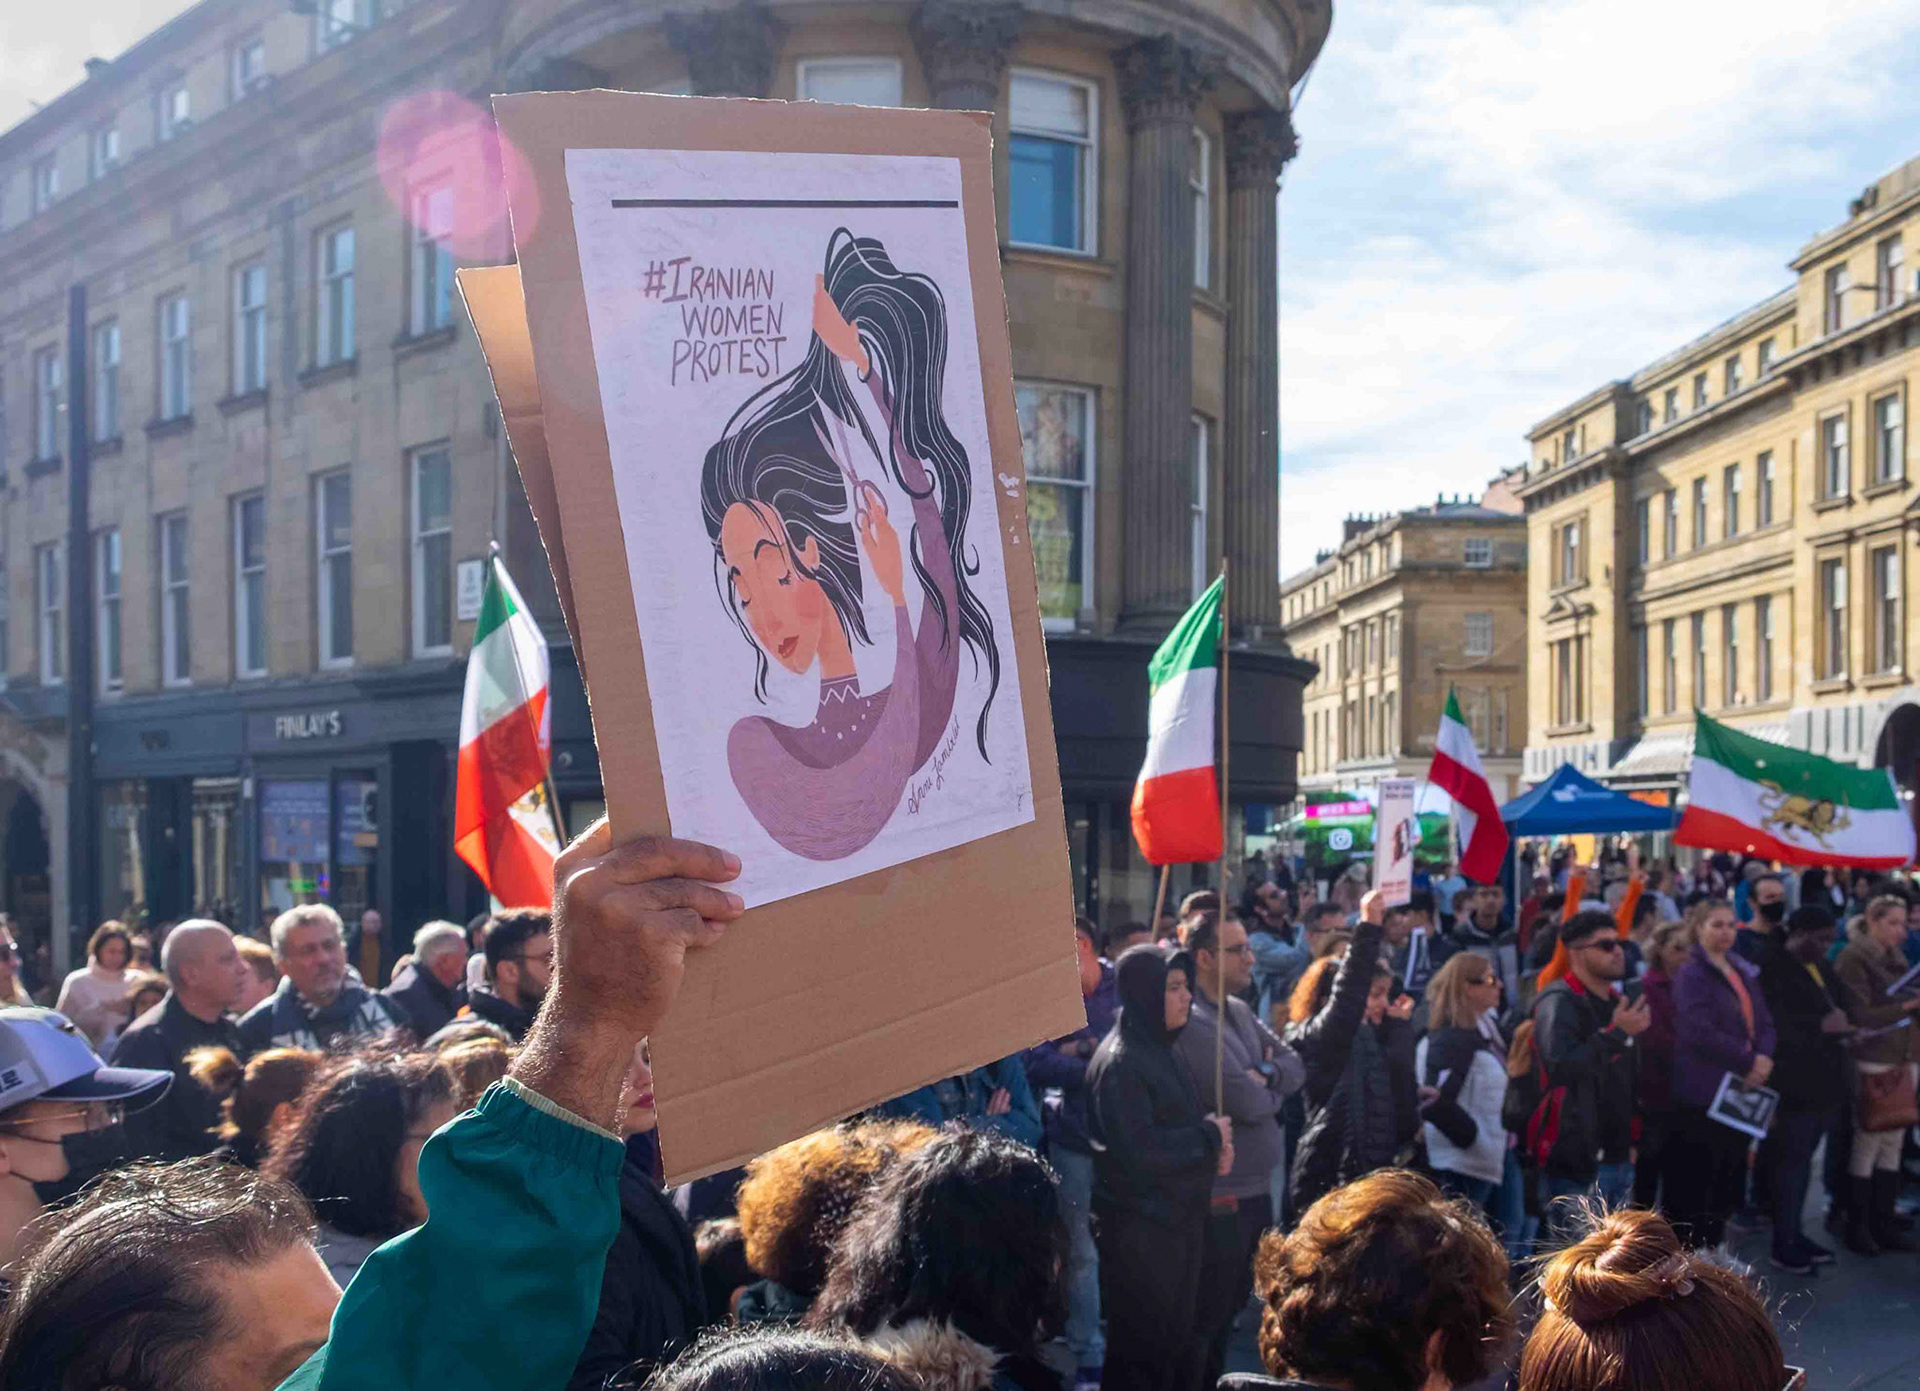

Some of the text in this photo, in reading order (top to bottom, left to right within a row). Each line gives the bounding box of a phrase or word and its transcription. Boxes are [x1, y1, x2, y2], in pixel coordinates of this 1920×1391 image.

[643, 256, 774, 303] #IRANIAN
[681, 302, 783, 339] WOMEN
[671, 336, 787, 387] PROTEST
[275, 710, 342, 739] FINLAY'S
